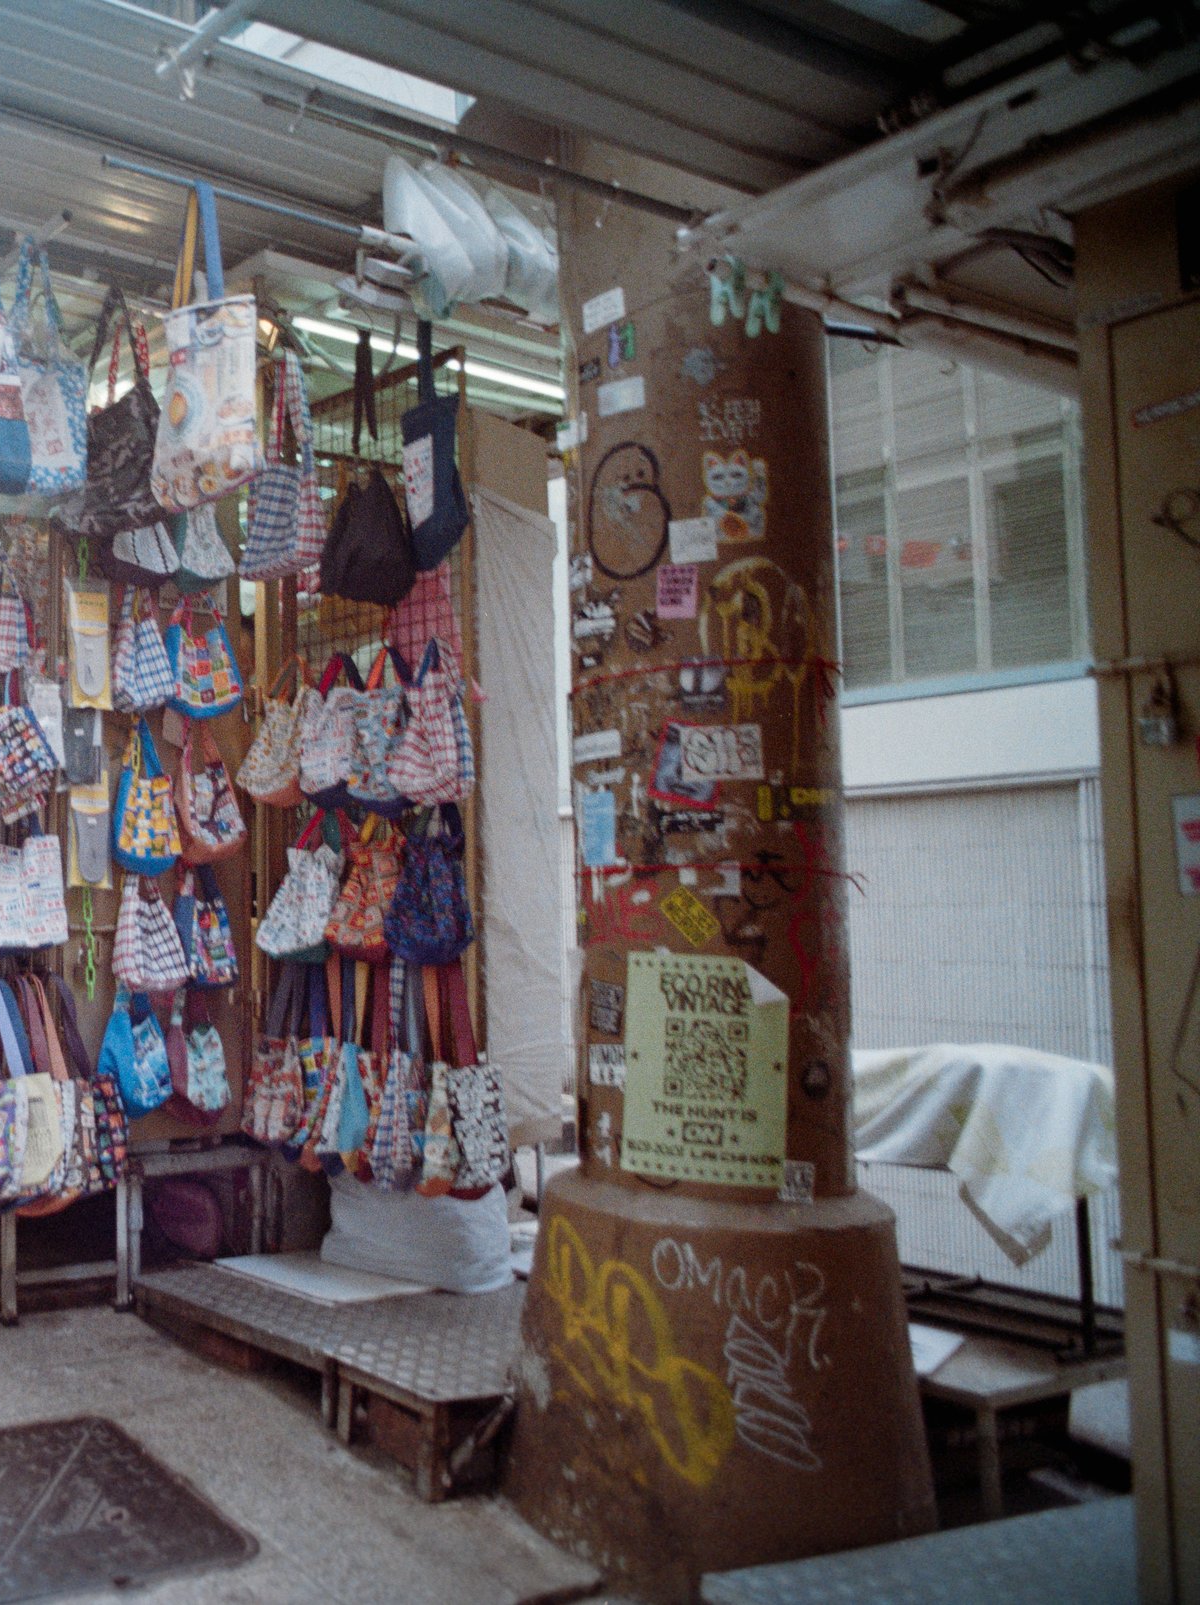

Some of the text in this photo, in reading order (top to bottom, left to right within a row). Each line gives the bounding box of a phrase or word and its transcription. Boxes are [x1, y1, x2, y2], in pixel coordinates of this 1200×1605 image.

[664, 990, 750, 1016] VINTAGE
[652, 1100, 758, 1123] THE HUNT IS
